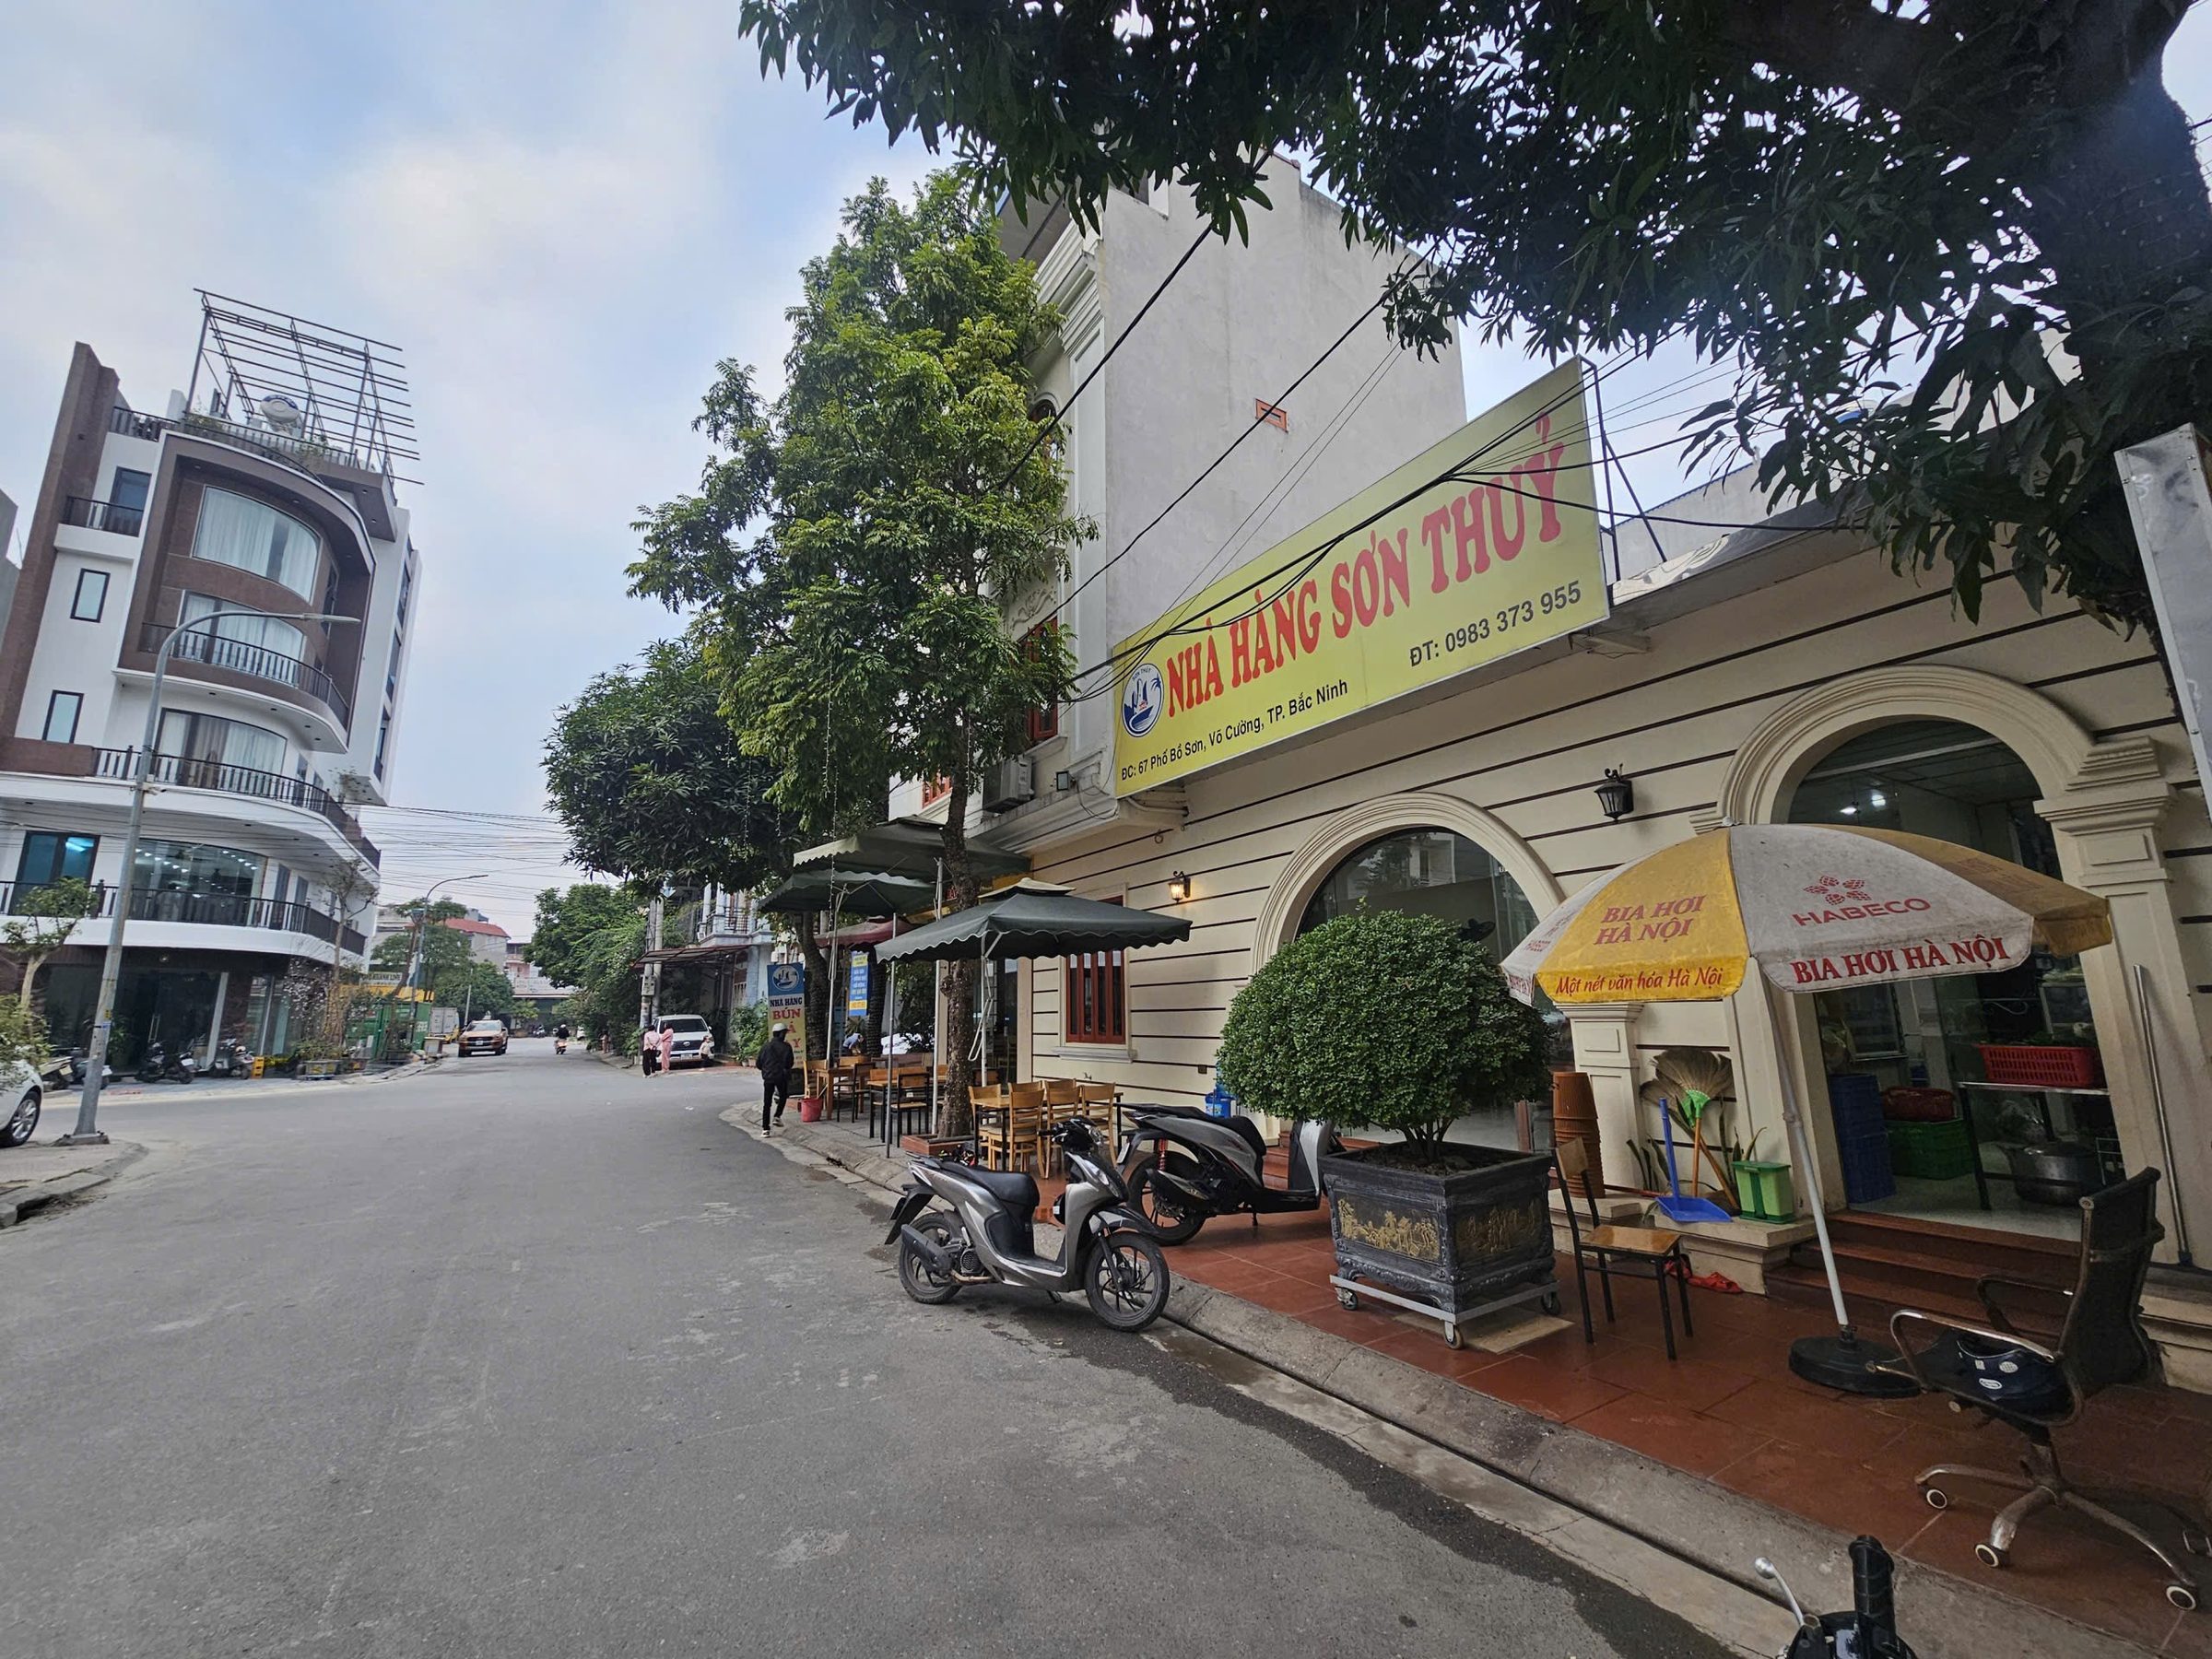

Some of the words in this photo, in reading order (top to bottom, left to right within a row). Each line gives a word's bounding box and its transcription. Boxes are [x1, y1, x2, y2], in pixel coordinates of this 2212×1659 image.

[1167, 618, 1224, 717] NHÀ
[1230, 589, 1321, 688] HÀNG
[1331, 527, 1410, 639] SƠN
[1409, 640, 1440, 667] ĐT:
[1445, 618, 1490, 653] 0983
[1496, 600, 1534, 633] 373
[1540, 580, 1582, 615] 955
[1122, 766, 1136, 781] ĐC:
[1138, 757, 1148, 774] 67
[1150, 747, 1169, 770] Phố
[1170, 744, 1183, 762] Bồ
[1184, 740, 1206, 757] Sơn,
[1209, 730, 1223, 747] Võ
[1225, 716, 1265, 740] Cường,
[1267, 705, 1286, 724] TP.
[1288, 692, 1312, 716] Bắc
[1316, 679, 1348, 705] Ninh
[1600, 904, 1644, 924] BIA
[1650, 894, 1707, 918] HƠI
[1792, 898, 1932, 926] HABECO
[1593, 922, 1632, 946] HÀ
[1637, 916, 1694, 943] NỘI
[1790, 957, 1843, 984] BIA
[1841, 948, 1898, 978] HƠI
[1900, 939, 1949, 970] HÀ
[1948, 934, 2011, 969] NỘI
[1555, 975, 1582, 997] Một
[1583, 974, 1606, 991] nét
[1607, 975, 1633, 991] văn
[1637, 971, 1664, 990] hóa
[1667, 968, 1690, 988] Hà
[1695, 965, 1724, 988] Nội
[772, 1007, 801, 1020] BÚN
